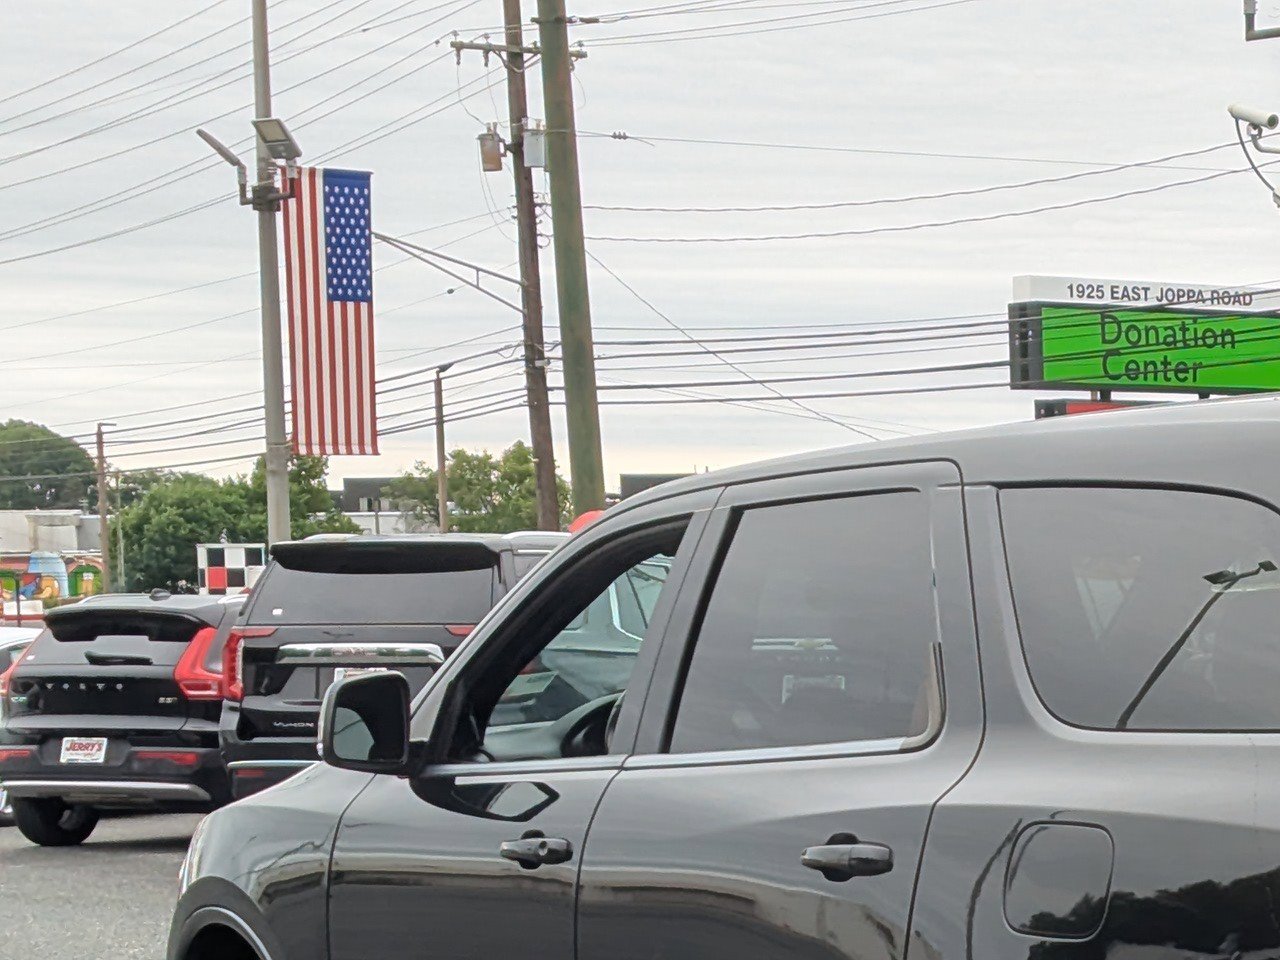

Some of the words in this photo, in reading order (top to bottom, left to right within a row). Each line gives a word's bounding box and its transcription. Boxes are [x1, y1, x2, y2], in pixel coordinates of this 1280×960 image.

[1067, 283, 1105, 299] 1925
[1110, 285, 1150, 301] EAST
[1155, 287, 1206, 303] JOPPA
[1210, 290, 1253, 306] ROAD
[1100, 314, 1236, 349] Donation
[1102, 350, 1203, 383] Center
